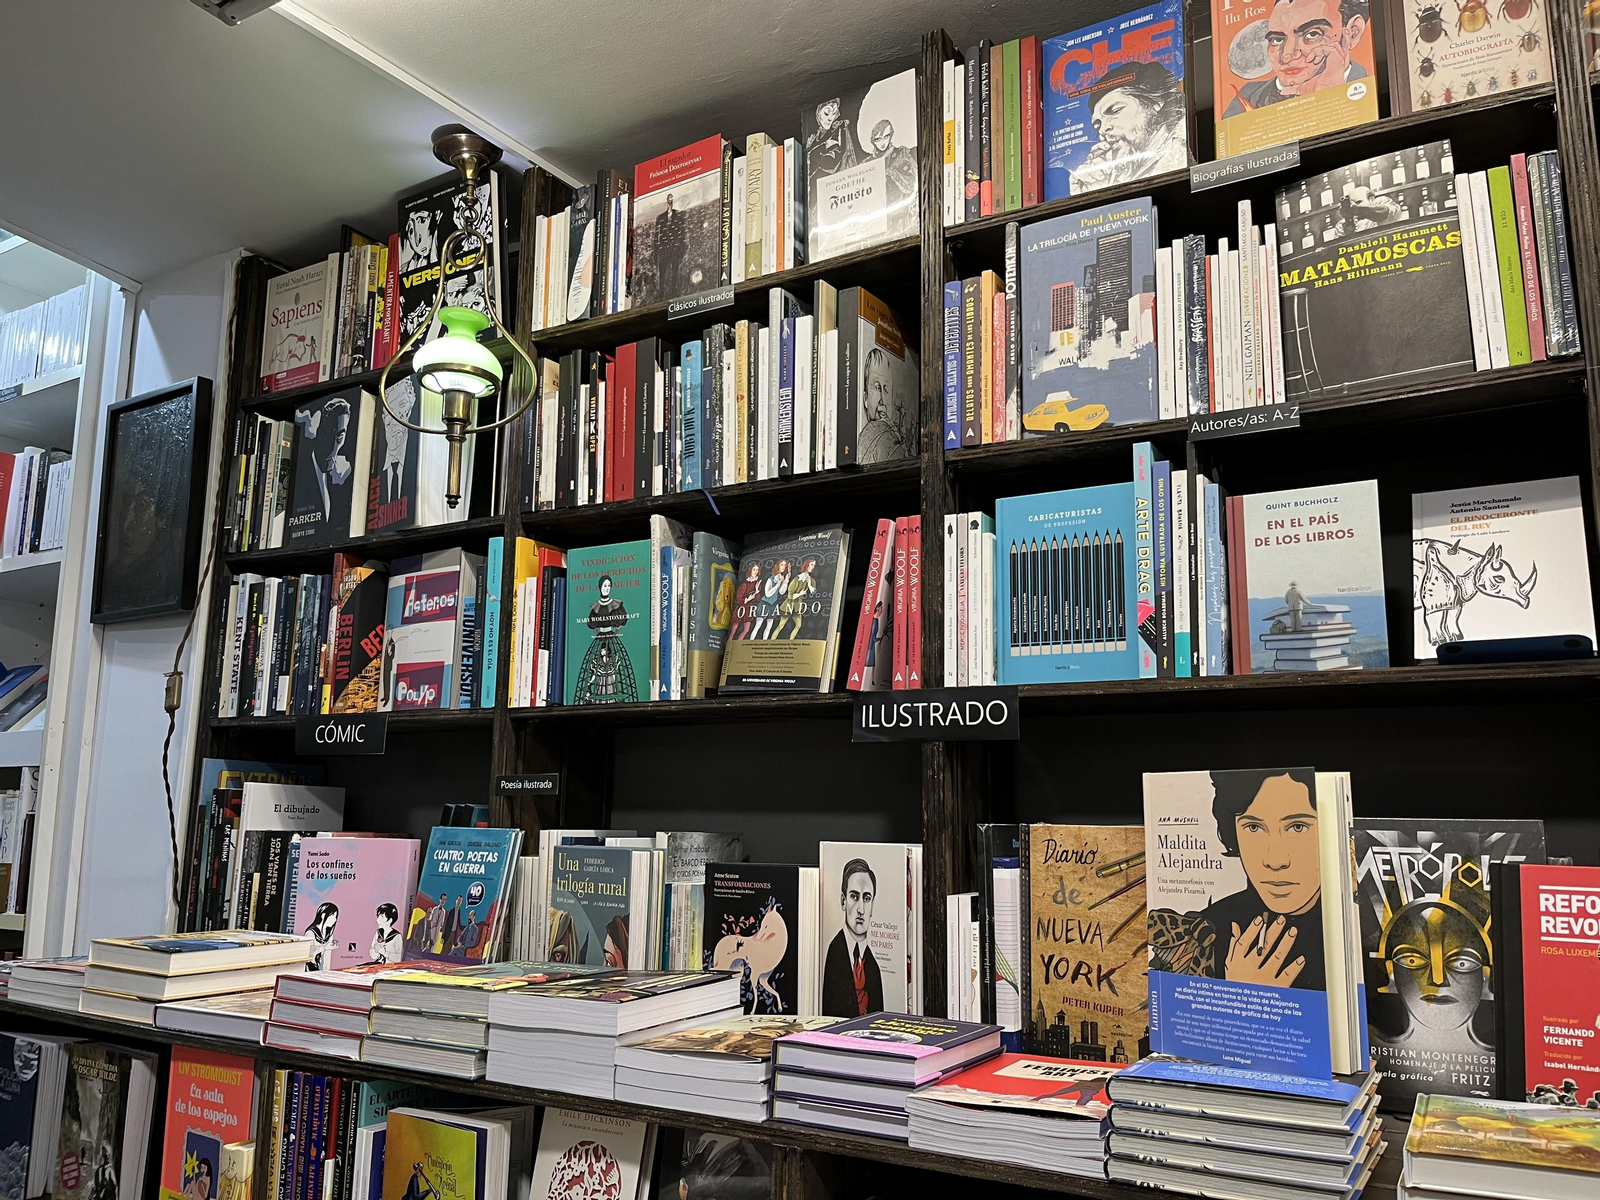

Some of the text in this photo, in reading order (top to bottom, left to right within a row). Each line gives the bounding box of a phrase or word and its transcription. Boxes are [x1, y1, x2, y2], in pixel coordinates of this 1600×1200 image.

[1119, 13, 1154, 30] JOSÉ HERNÁNDEZ
[1224, 6, 1266, 26] Ilu Ros
[1439, 37, 1514, 62] AUTOBIOGRAFÍA
[1449, 32, 1501, 50] Charles Darwin
[1050, 18, 1176, 93] CHE
[667, 150, 692, 165] jugador
[1193, 150, 1298, 183] Biografías ilustradas
[835, 176, 867, 192] GOETHE
[829, 185, 873, 211] Fausto
[1080, 207, 1142, 228] Paul Auster
[1027, 243, 1039, 253] LA
[1039, 232, 1078, 251] TRILOGÍA
[1079, 229, 1091, 239] DE
[1123, 214, 1150, 227] YORK
[1338, 223, 1449, 255] Dashiell Hammett
[1279, 230, 1462, 288] MATAMOSCAS
[1005, 245, 1017, 300] POTEMKIN
[1314, 261, 1403, 289] Hans Hillmann
[668, 289, 734, 313] Clásicos ilustrados
[271, 299, 323, 329] Sapiens
[1058, 354, 1083, 367] WALK
[778, 387, 792, 444] FRANKENSTEIN
[1191, 406, 1300, 434] Autores/as: A-Z
[1265, 496, 1339, 510] QUINT BUCHHOLZ
[1449, 495, 1522, 509] Jesús Marchamalo
[1449, 503, 1510, 515] Antonio Santos
[289, 511, 322, 527] PARKER
[1028, 507, 1103, 523] CARICATURISTAS
[1159, 512, 1166, 521] DE
[1266, 512, 1340, 531] EN EL PAÍS
[1450, 509, 1539, 524] EL RINOCERONTE
[1450, 522, 1492, 532] DEL REY
[1135, 497, 1151, 595] ARTE DRAG
[1254, 528, 1355, 548] DE LOS LIBROS
[581, 554, 636, 567] VINDICACIÓN
[896, 548, 906, 587] WOOLF
[909, 546, 920, 586] WOOLF
[570, 566, 646, 581] DE LOS DERECHOS
[1159, 557, 1167, 587] HISTORIA
[575, 584, 587, 593] DE
[613, 579, 641, 590] MUJER
[661, 572, 669, 609] WOOLF
[864, 549, 883, 616] VIRGINIA WOOLF
[576, 612, 641, 624] MARY WOLLSTONECRAFT
[737, 601, 822, 619] ORLANDO
[230, 616, 244, 694] KENT STATE
[335, 613, 354, 680] BERLÍN
[861, 699, 1009, 728] ILUSTRADO
[315, 719, 366, 744] CÓMIC
[500, 780, 552, 789] Poesía ilustrada
[273, 804, 320, 816] El dibujado
[1157, 834, 1207, 850] Maldita
[433, 849, 499, 863] CUATRO POETAS
[584, 857, 606, 866] FEDERICO
[1041, 838, 1099, 866] Diario
[271, 855, 280, 883] VIAJES
[306, 859, 354, 870] Los confines
[438, 861, 486, 875] EN GUERRA
[557, 852, 580, 872] Una
[1157, 853, 1223, 873] Alejandra
[305, 870, 356, 881] de los sueños
[713, 880, 771, 889] TRANSFORMACIONES
[1168, 878, 1203, 886] metamorfosis
[263, 878, 272, 907] TIERRA
[270, 885, 277, 896] DE
[470, 885, 482, 897] 40
[556, 874, 627, 898] trilogía rural
[1052, 875, 1083, 909] de
[1157, 886, 1206, 895] Alejandra Pizarnik
[870, 921, 899, 931] César Vallejo
[870, 930, 901, 940] ME MORIRÉ
[1036, 916, 1104, 953] NUEVA
[870, 939, 894, 950] EN PARÍS
[1039, 953, 1119, 997] YORK
[1062, 995, 1125, 1017] PETER KUPER
[1542, 1015, 1580, 1025] Ilustrado por
[1543, 1025, 1595, 1038] FERNANDO
[1543, 1035, 1584, 1048] VICENTE
[1544, 1051, 1583, 1061] Traducido por
[78, 1066, 118, 1082] OSCAR WILDE
[178, 1061, 243, 1086] LIV STRÖMQUIST
[1022, 1063, 1114, 1076] FEMINIST
[1544, 1060, 1600, 1073] Isabel Hernánd
[1451, 1072, 1491, 1087] FRITZ
[190, 1082, 225, 1105] La sala
[175, 1098, 238, 1128] de los espejos
[300, 1085, 310, 1153] MARCO AURELIO
[311, 1084, 321, 1141] MAQUIAVELO
[322, 1087, 331, 1136] DESCARTES
[558, 1109, 632, 1128] EMILY DICKINSON
